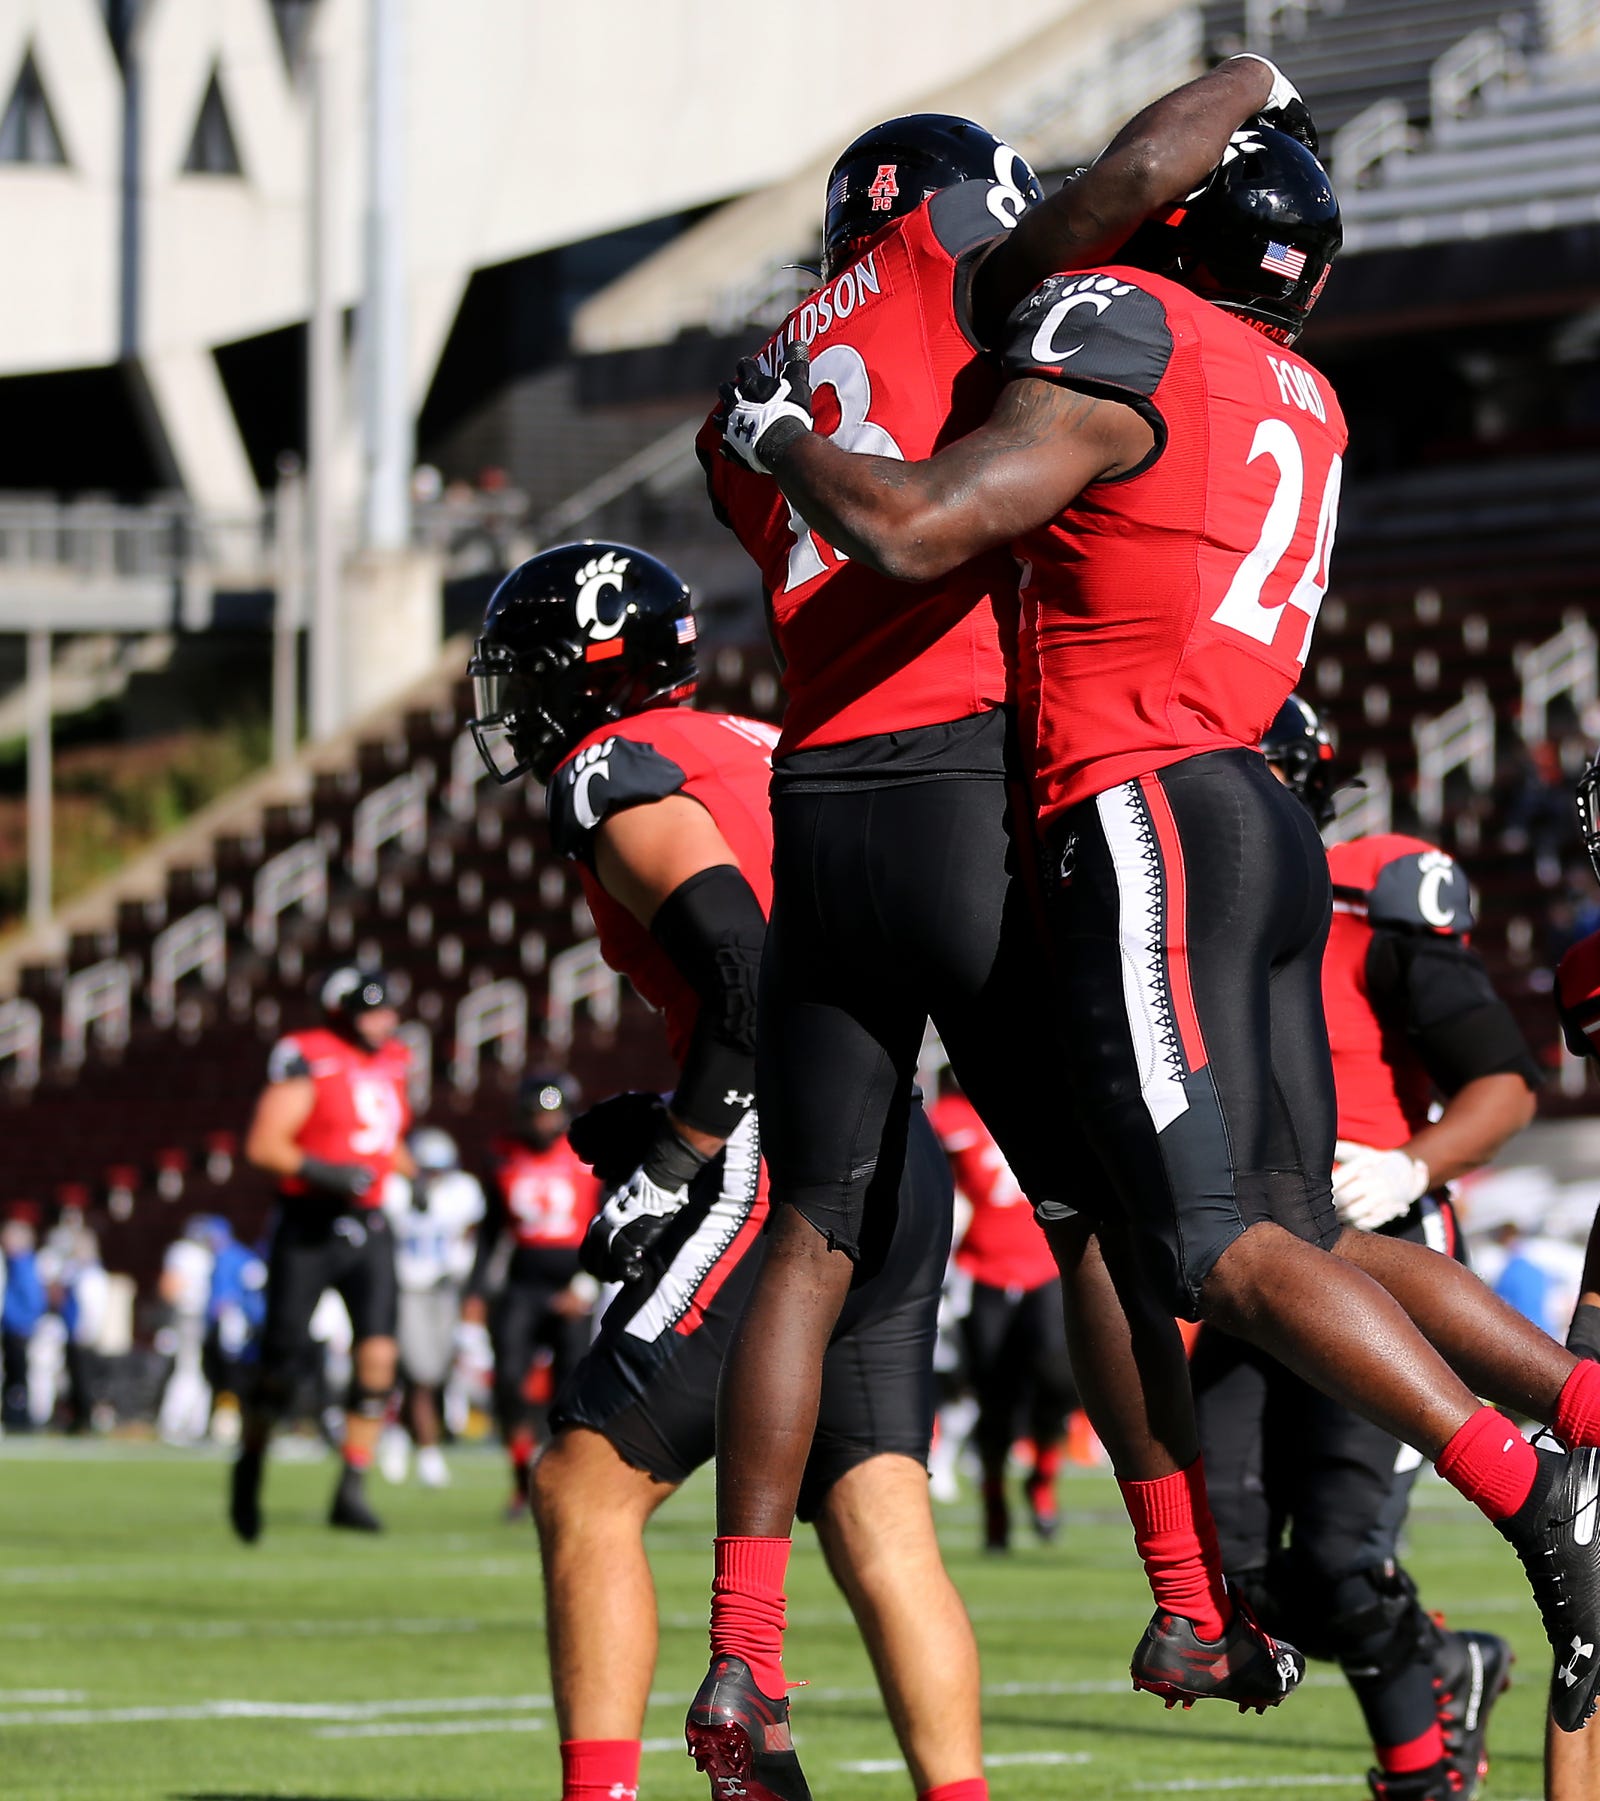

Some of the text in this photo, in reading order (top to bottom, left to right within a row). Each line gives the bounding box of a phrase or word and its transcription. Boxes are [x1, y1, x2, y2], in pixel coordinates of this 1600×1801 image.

[871, 197, 892, 211] P6
[1265, 353, 1327, 425] FORD
[1210, 417, 1343, 669] 24
